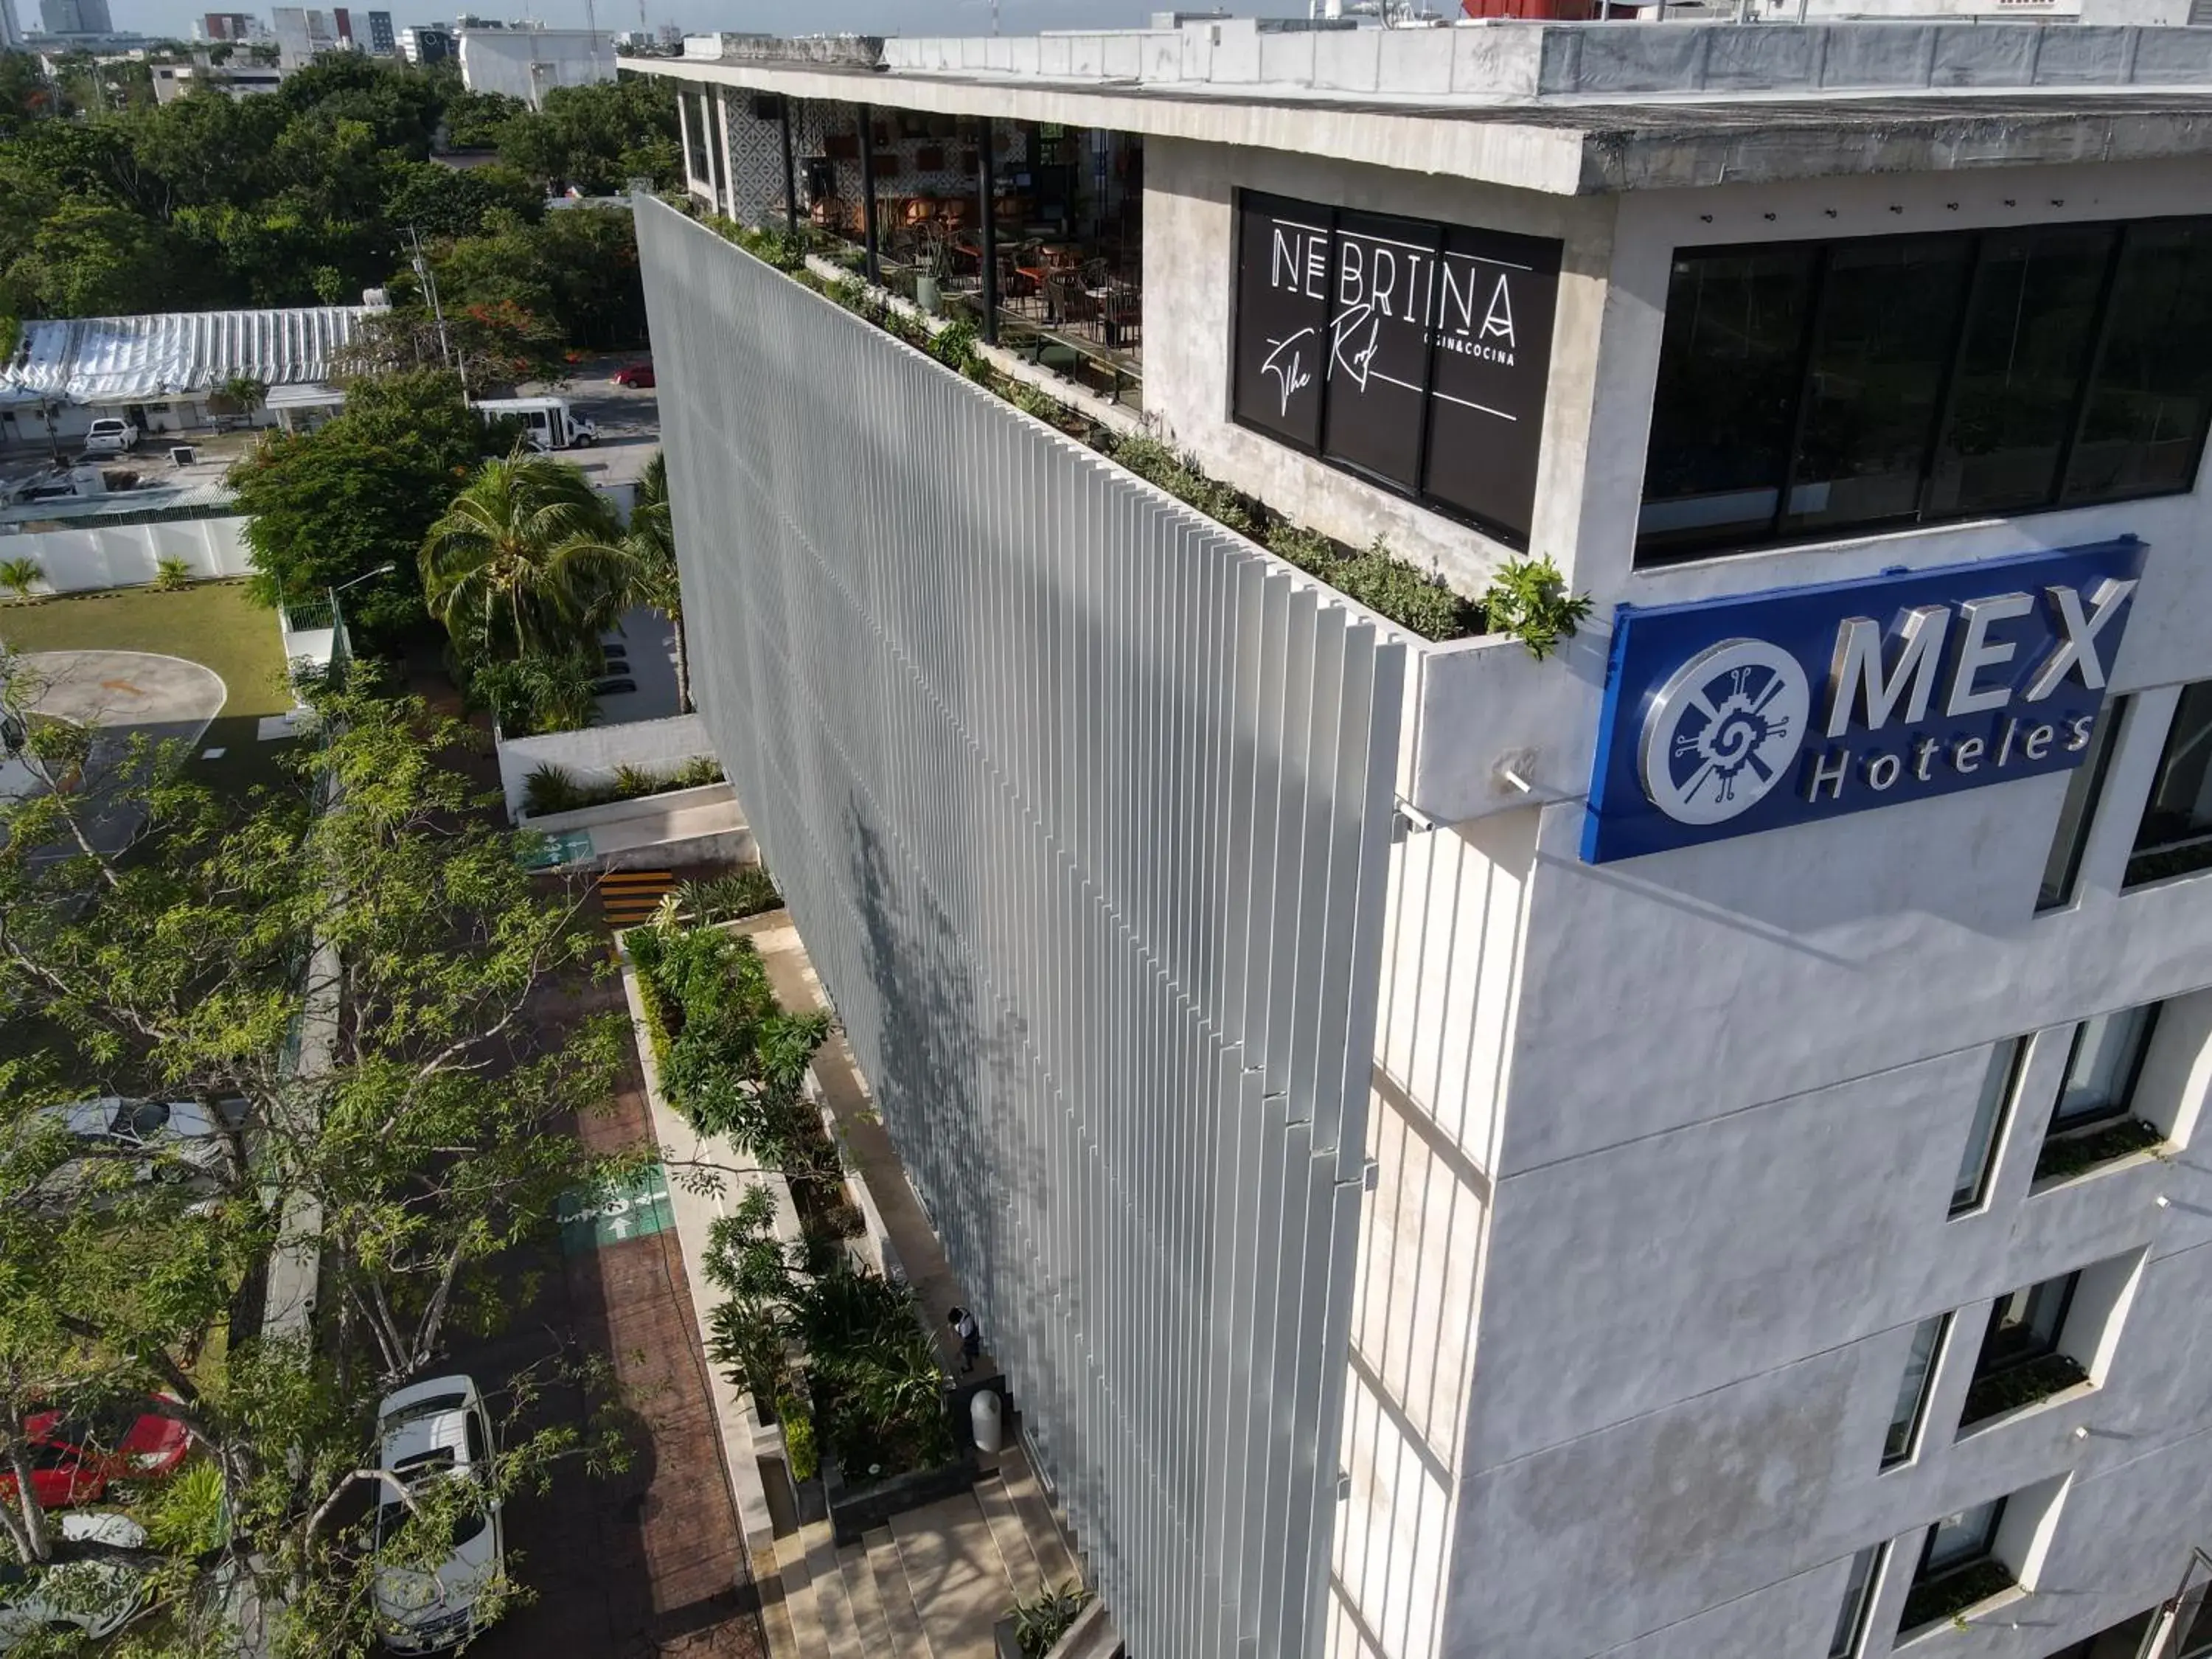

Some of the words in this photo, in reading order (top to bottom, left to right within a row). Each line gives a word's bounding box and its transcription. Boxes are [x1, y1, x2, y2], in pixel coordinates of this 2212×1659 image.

[1272, 228, 1516, 349] NEBRINA
[1262, 327, 1321, 417] The
[1824, 577, 2139, 738] MEX
[1805, 714, 2093, 804] Hoteles
